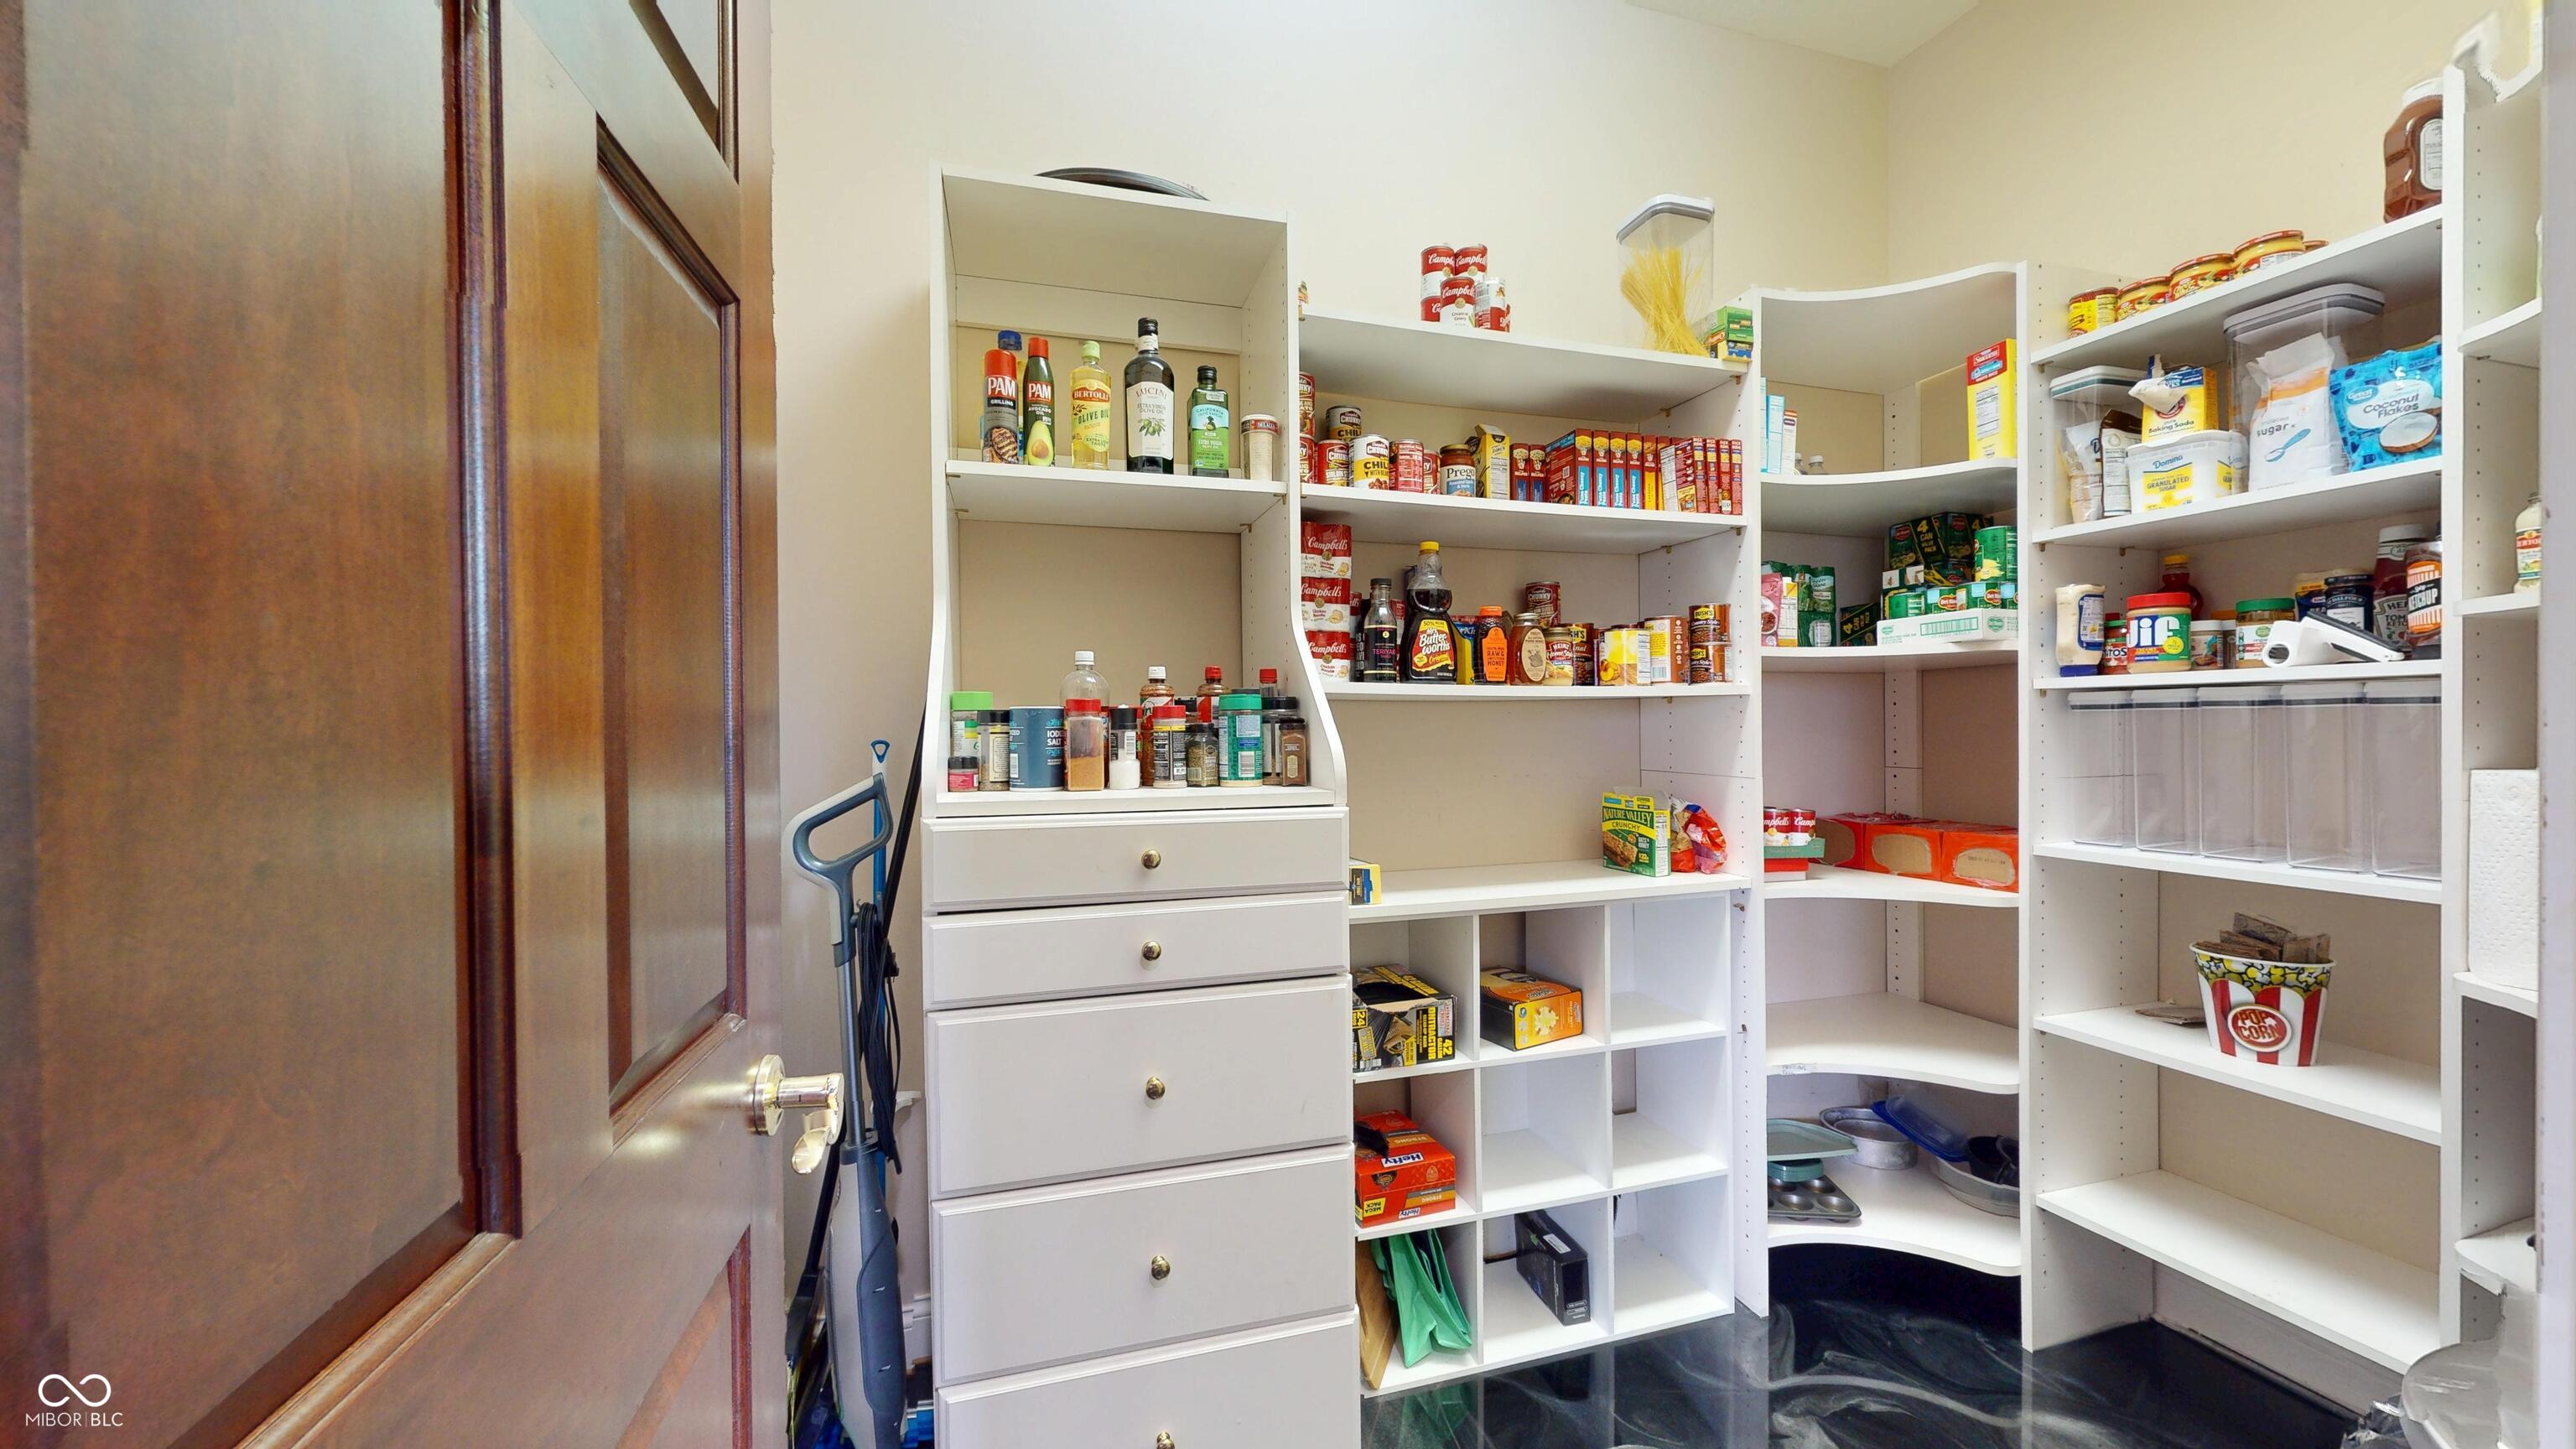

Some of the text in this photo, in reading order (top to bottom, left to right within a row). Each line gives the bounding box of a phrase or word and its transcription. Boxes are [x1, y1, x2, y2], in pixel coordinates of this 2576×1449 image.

[987, 377, 1016, 398] PAM
[1028, 383, 1052, 401] PAM
[1073, 389, 1109, 401] BERTOLLI
[1135, 387, 1167, 399] LUCINI
[2363, 393, 2420, 414] Coconut
[2378, 402, 2420, 419] Flakes
[1078, 408, 1109, 425] OLIVE OIL
[2148, 419, 2194, 434] Baking Soda
[2257, 423, 2289, 438] sugar
[2153, 454, 2184, 470] Domino
[1446, 467, 1475, 480] Prego
[2147, 475, 2189, 490] GRANULATED
[1917, 519, 1928, 532] 4
[1307, 536, 1348, 551] Campbell's
[1920, 532, 1933, 542] CAN
[1301, 583, 1343, 598] Campbell's
[1570, 628, 1585, 639] SH'S
[1307, 641, 1347, 656] Campbell's
[1552, 642, 1570, 651] HEINZ
[1046, 738, 1062, 746] SALT
[1602, 807, 1652, 828] NATURE VALLEY
[1612, 821, 1641, 832] CRUNCHY
[1357, 1011, 1366, 1027] 24
[2236, 1009, 2269, 1026] POP
[1427, 1006, 1436, 1060] ONTRACTOR
[2239, 1024, 2278, 1041] CORN
[1442, 1039, 1453, 1057] 42
[1384, 1153, 1422, 1165] Hefty
[1400, 1208, 1420, 1217] Hefty
